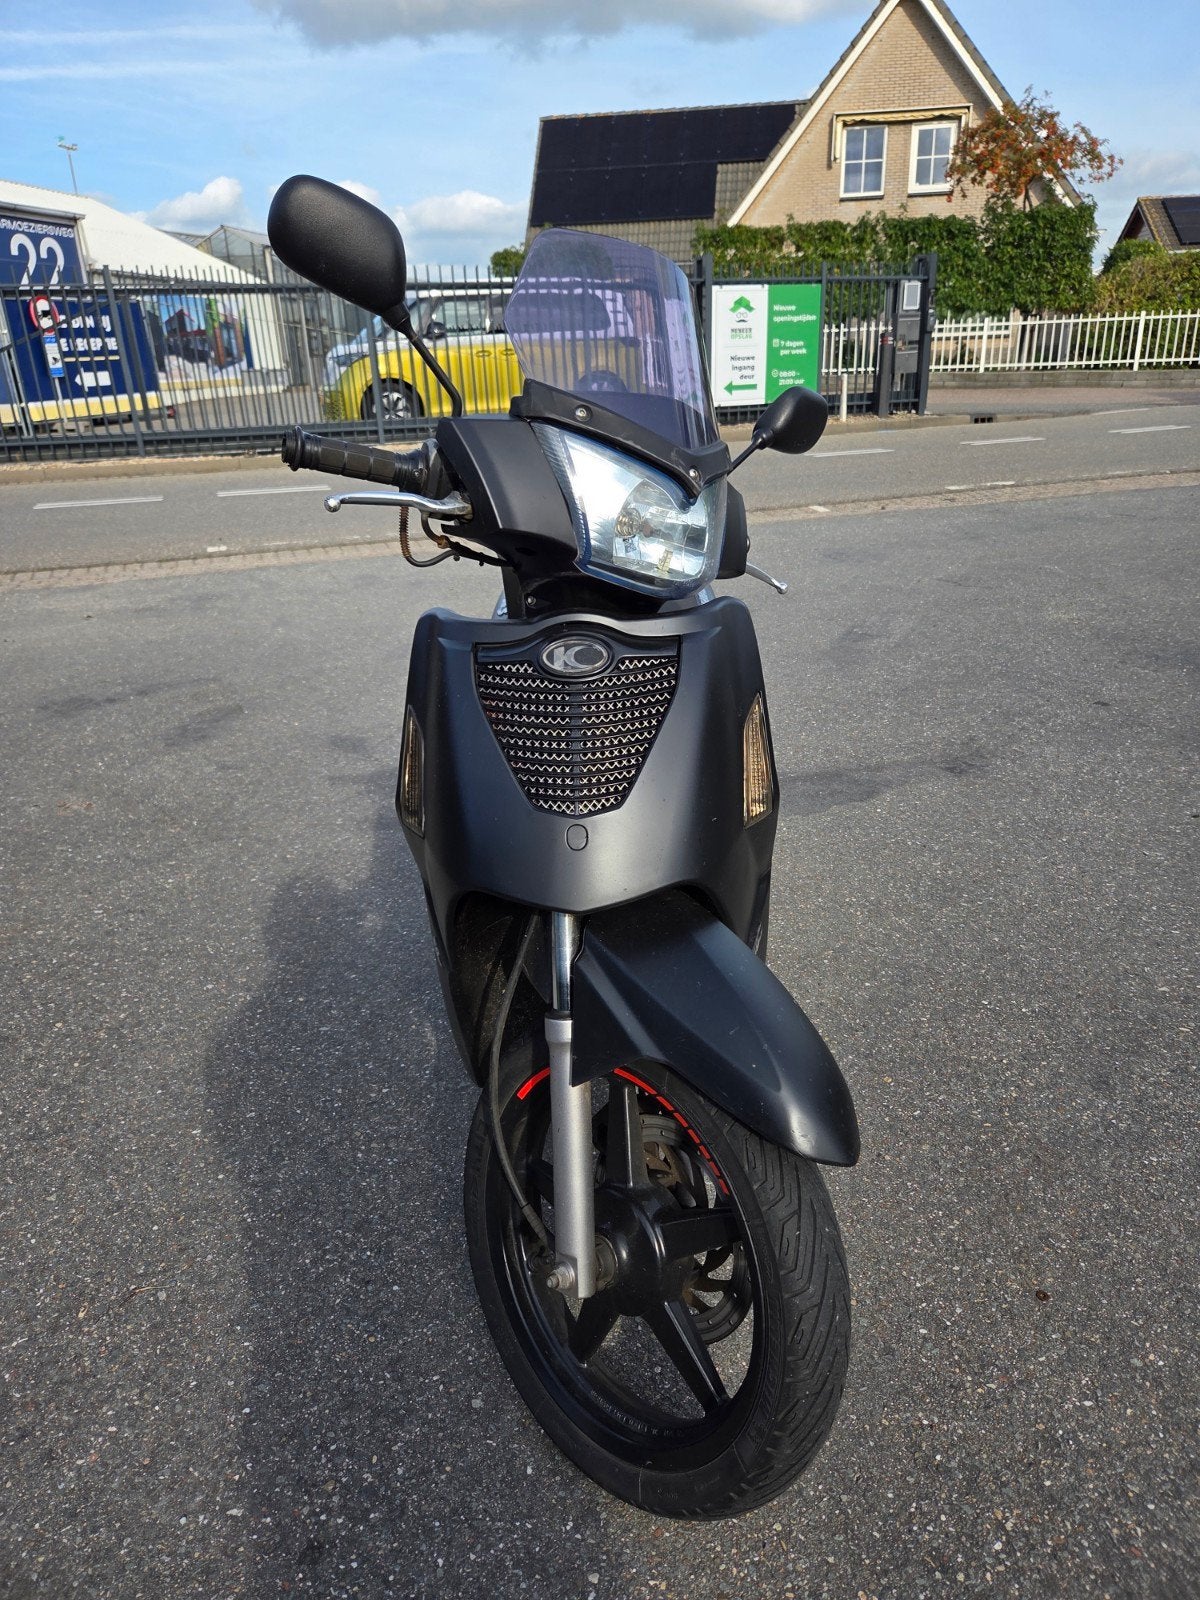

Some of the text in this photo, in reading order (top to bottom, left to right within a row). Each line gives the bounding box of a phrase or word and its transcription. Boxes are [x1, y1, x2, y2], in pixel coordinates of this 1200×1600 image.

[0, 218, 74, 238] RMOEZIERSWEG
[10, 233, 71, 290] 22
[773, 304, 796, 312] Nieuwe
[773, 314, 817, 323] openingstijden
[785, 340, 804, 348] dagen
